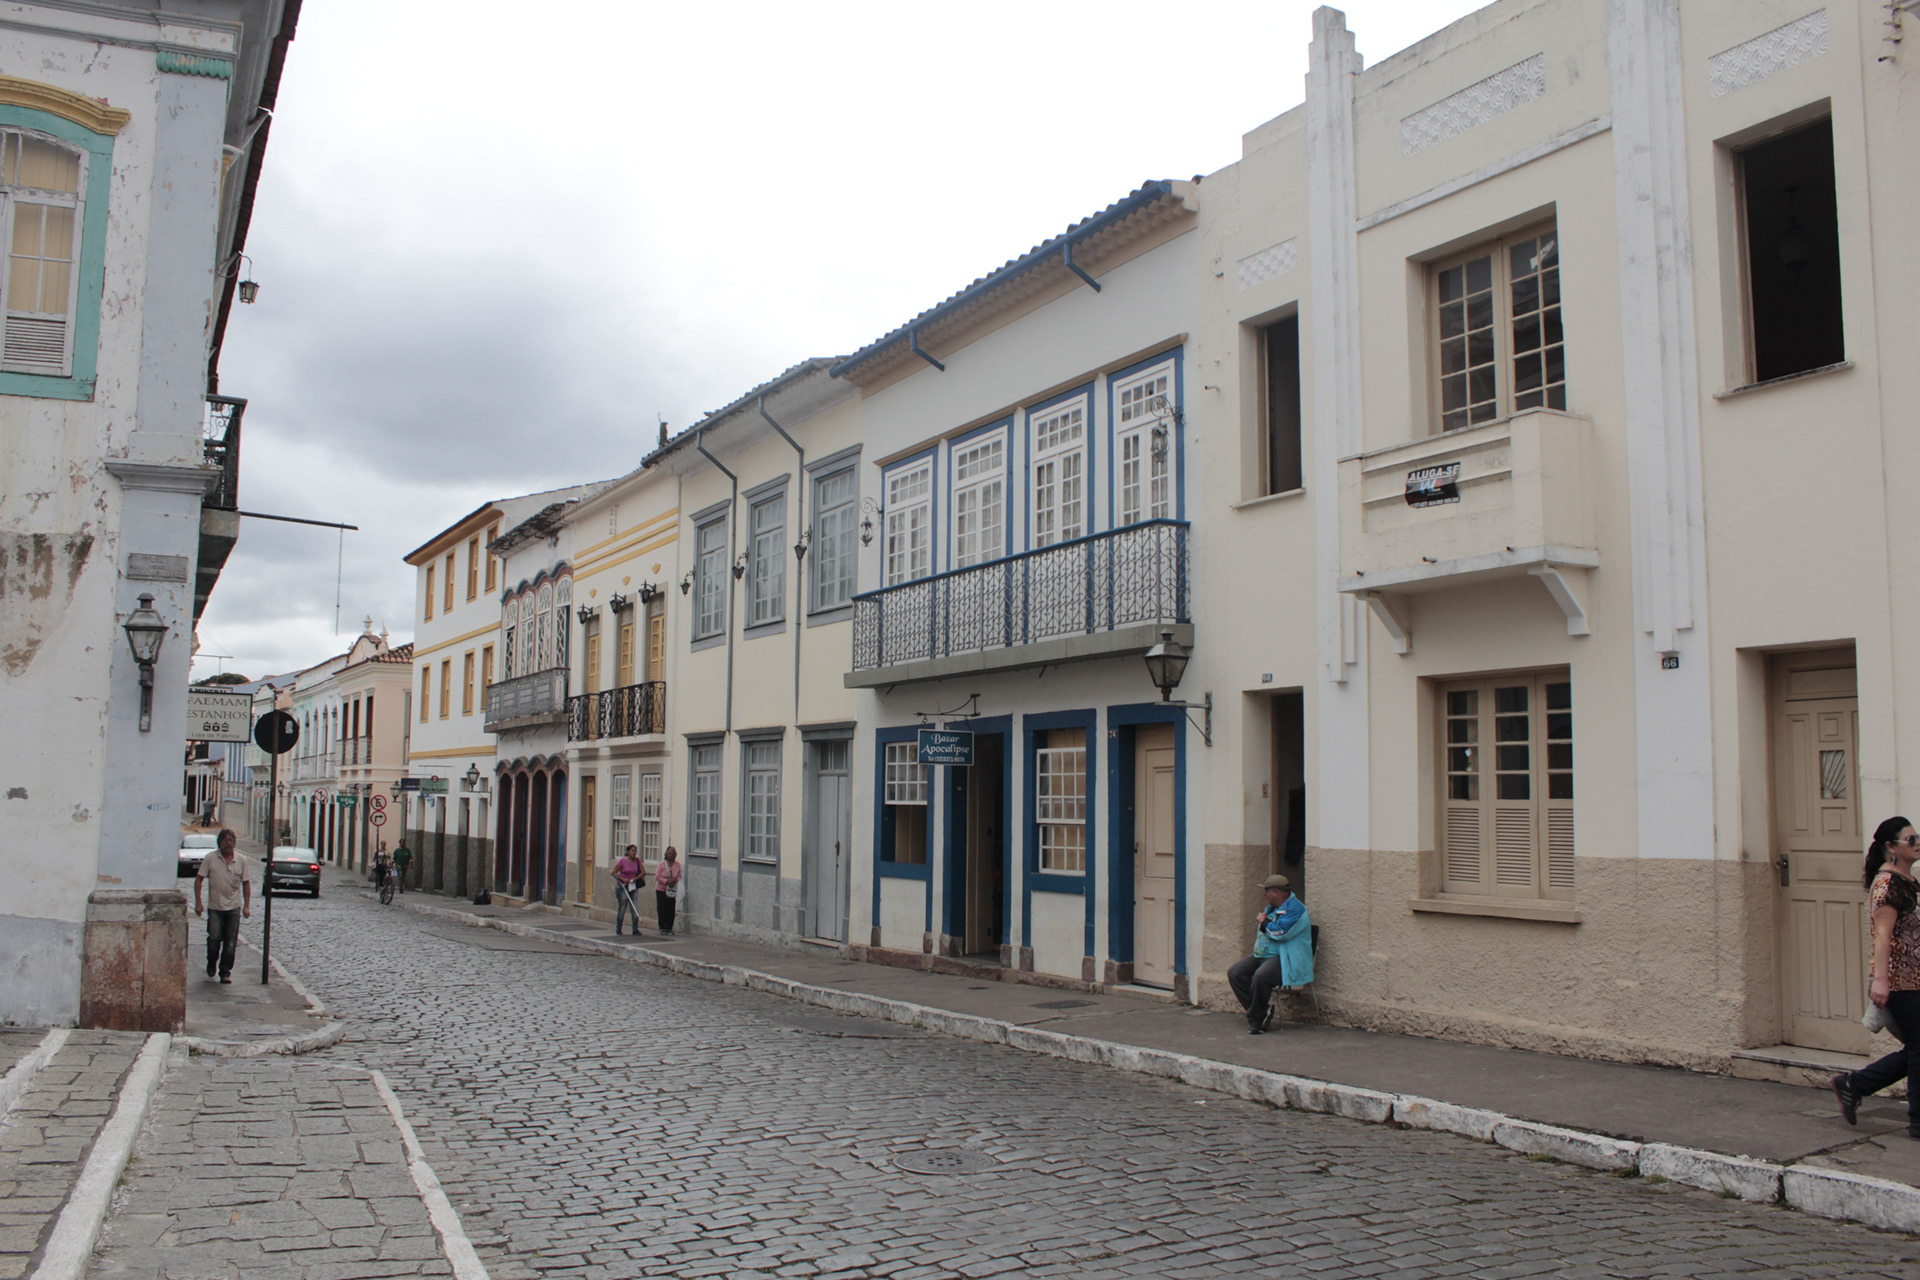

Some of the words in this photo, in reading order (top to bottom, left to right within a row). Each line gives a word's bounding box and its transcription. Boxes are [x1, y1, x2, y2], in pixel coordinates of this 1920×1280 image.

[1663, 658, 1677, 668] 66
[187, 709, 248, 720] ESTANHOS
[930, 733, 960, 744] Bazar
[921, 744, 970, 756] Apocalipse
